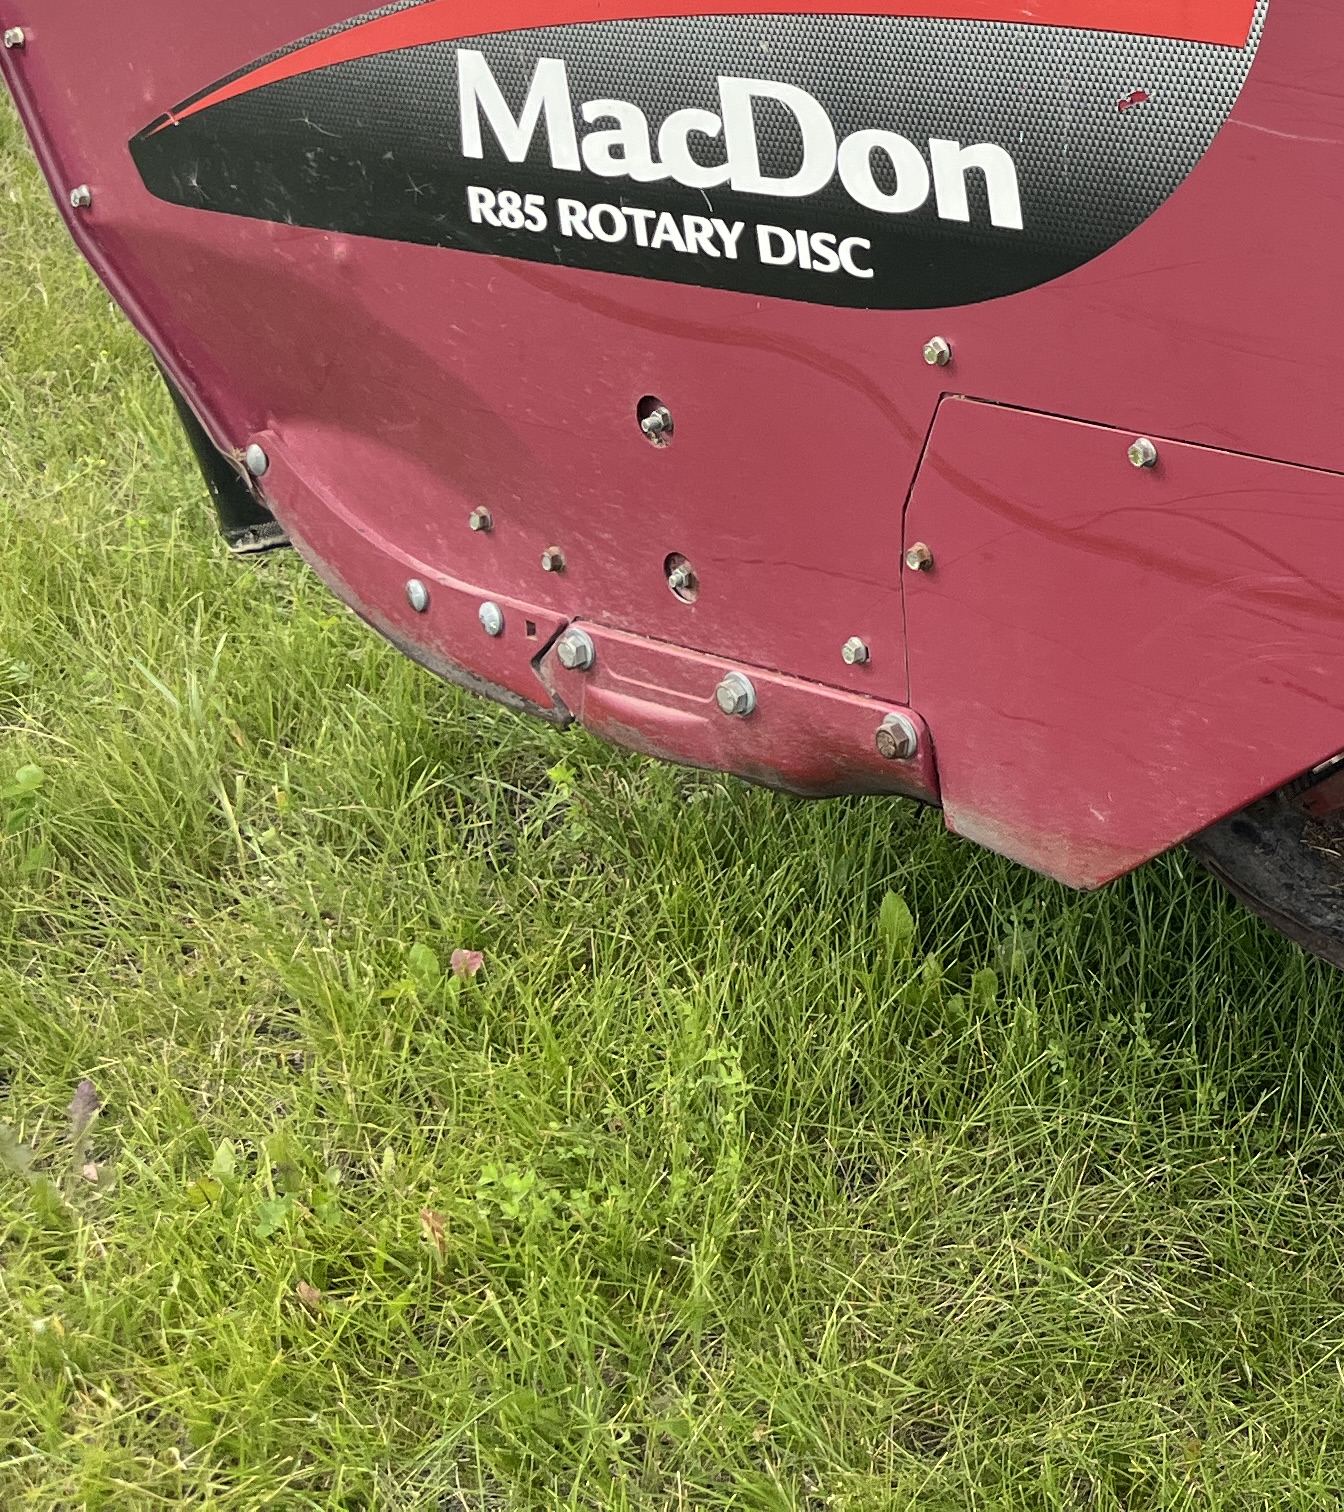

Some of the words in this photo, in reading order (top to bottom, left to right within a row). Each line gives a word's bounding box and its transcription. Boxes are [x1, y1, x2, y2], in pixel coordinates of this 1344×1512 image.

[455, 48, 1024, 230] MacDon
[467, 186, 548, 232] R85
[558, 197, 745, 259] ROTARY
[756, 224, 874, 278] DISC
